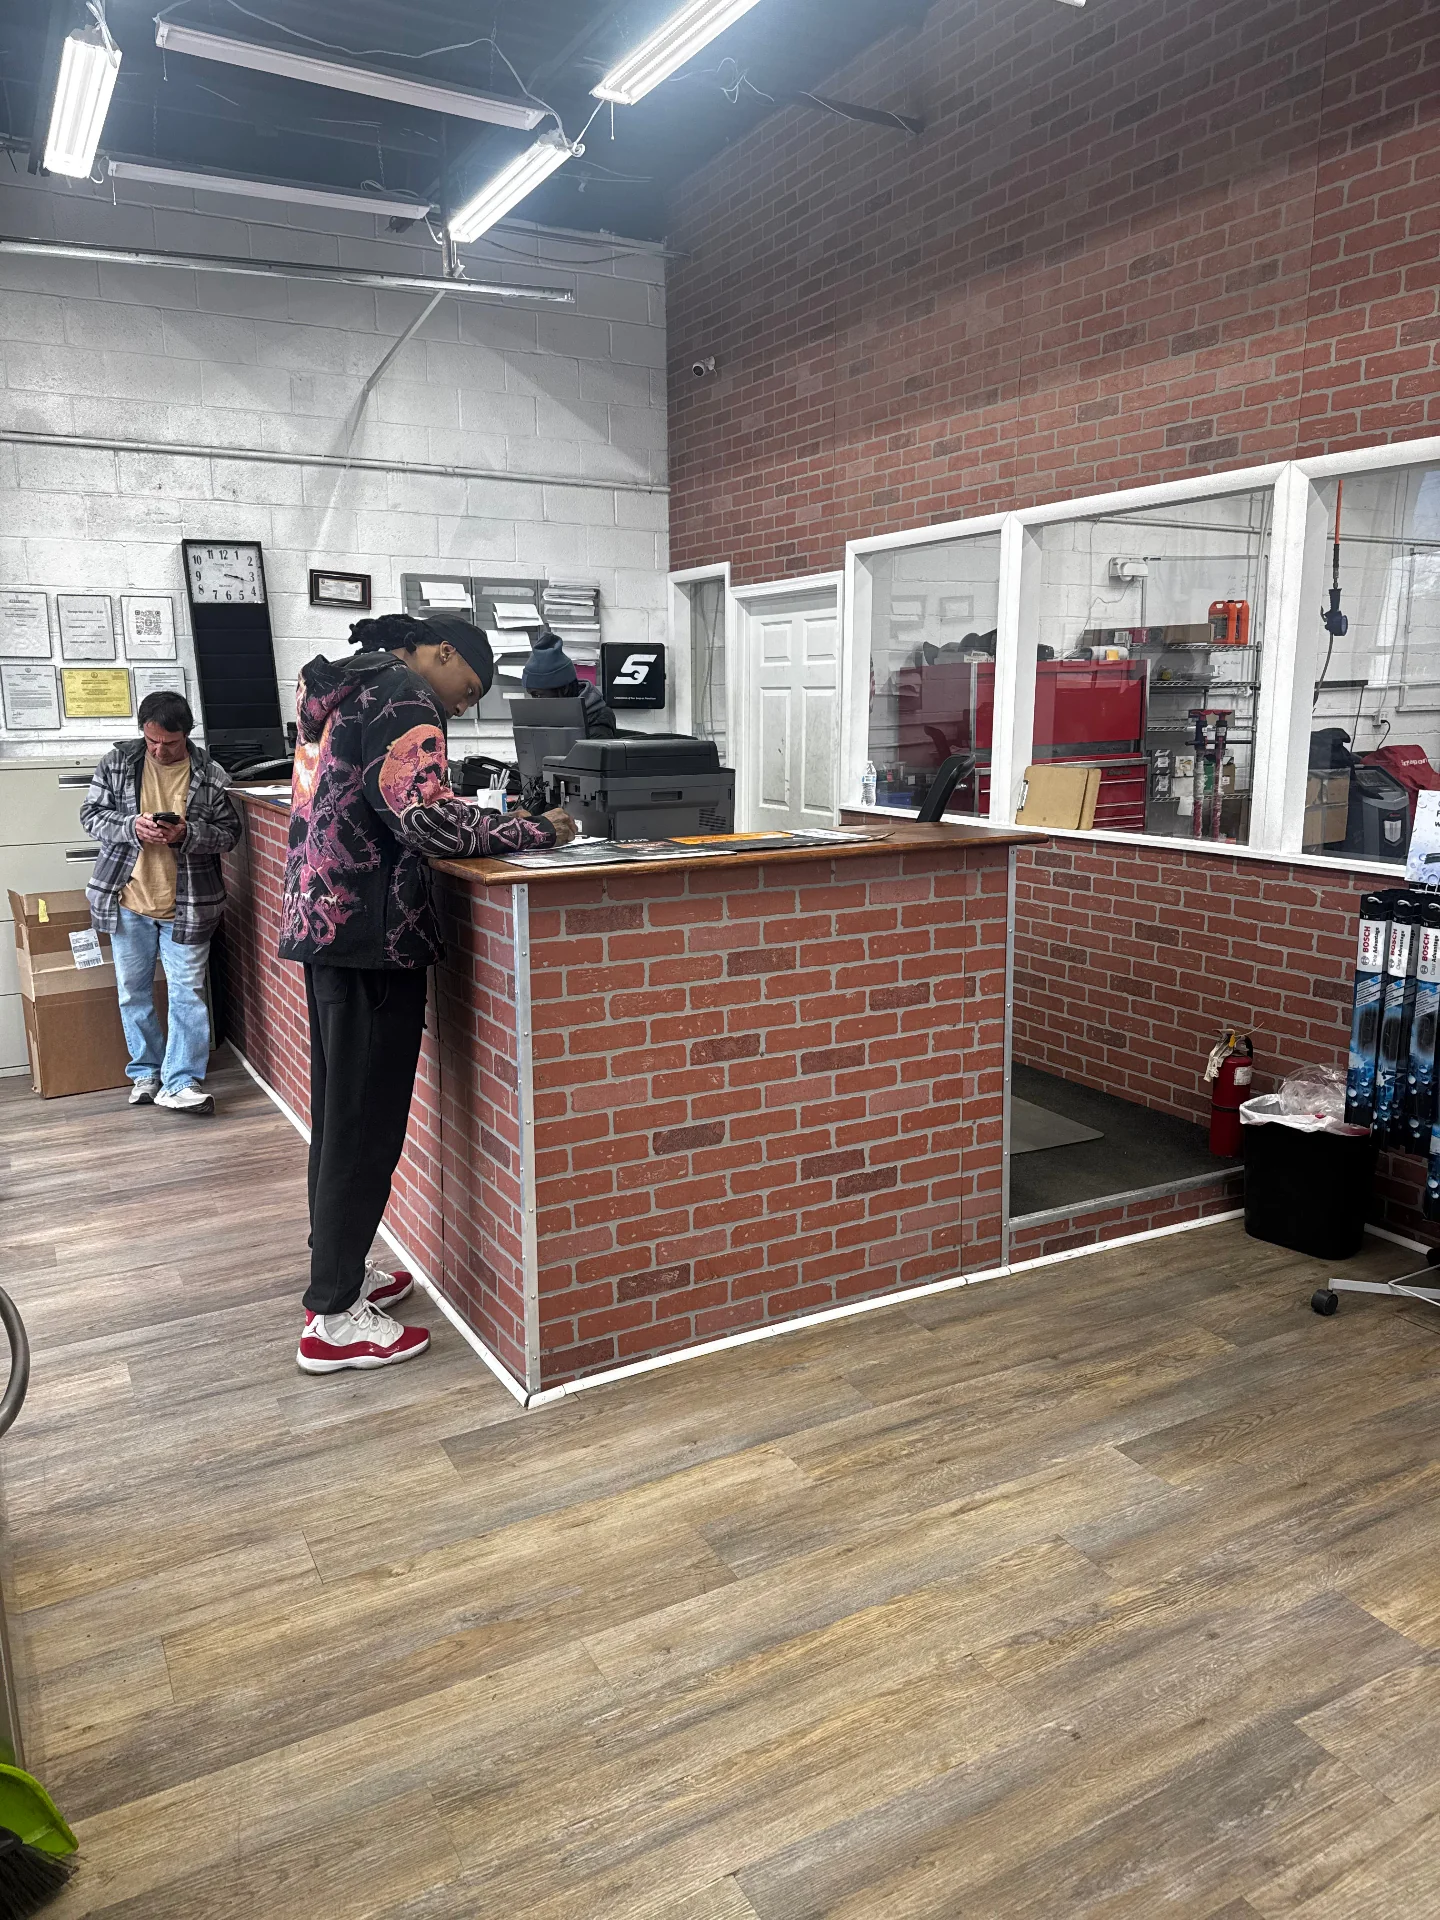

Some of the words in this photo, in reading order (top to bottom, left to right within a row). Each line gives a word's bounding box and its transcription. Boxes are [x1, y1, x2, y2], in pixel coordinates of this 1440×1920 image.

[207, 549, 213, 559] 11
[219, 550, 228, 560] 12
[234, 550, 239, 560] 1
[192, 555, 202, 565] 10
[247, 556, 253, 566] 2
[196, 571, 201, 581] 9
[249, 572, 254, 582] 3
[198, 584, 204, 595] 8
[251, 586, 256, 596] 4
[213, 590, 218, 600] 7
[226, 590, 232, 600] 6
[239, 590, 244, 600] 5
[1362, 926, 1371, 953] BOSCH
[1372, 927, 1381, 954] Advantage
[1390, 928, 1398, 956] BOSCH
[1398, 930, 1406, 957] Advantage
[1421, 934, 1430, 961] BOSCH
[1431, 935, 1440, 963] Advantage
